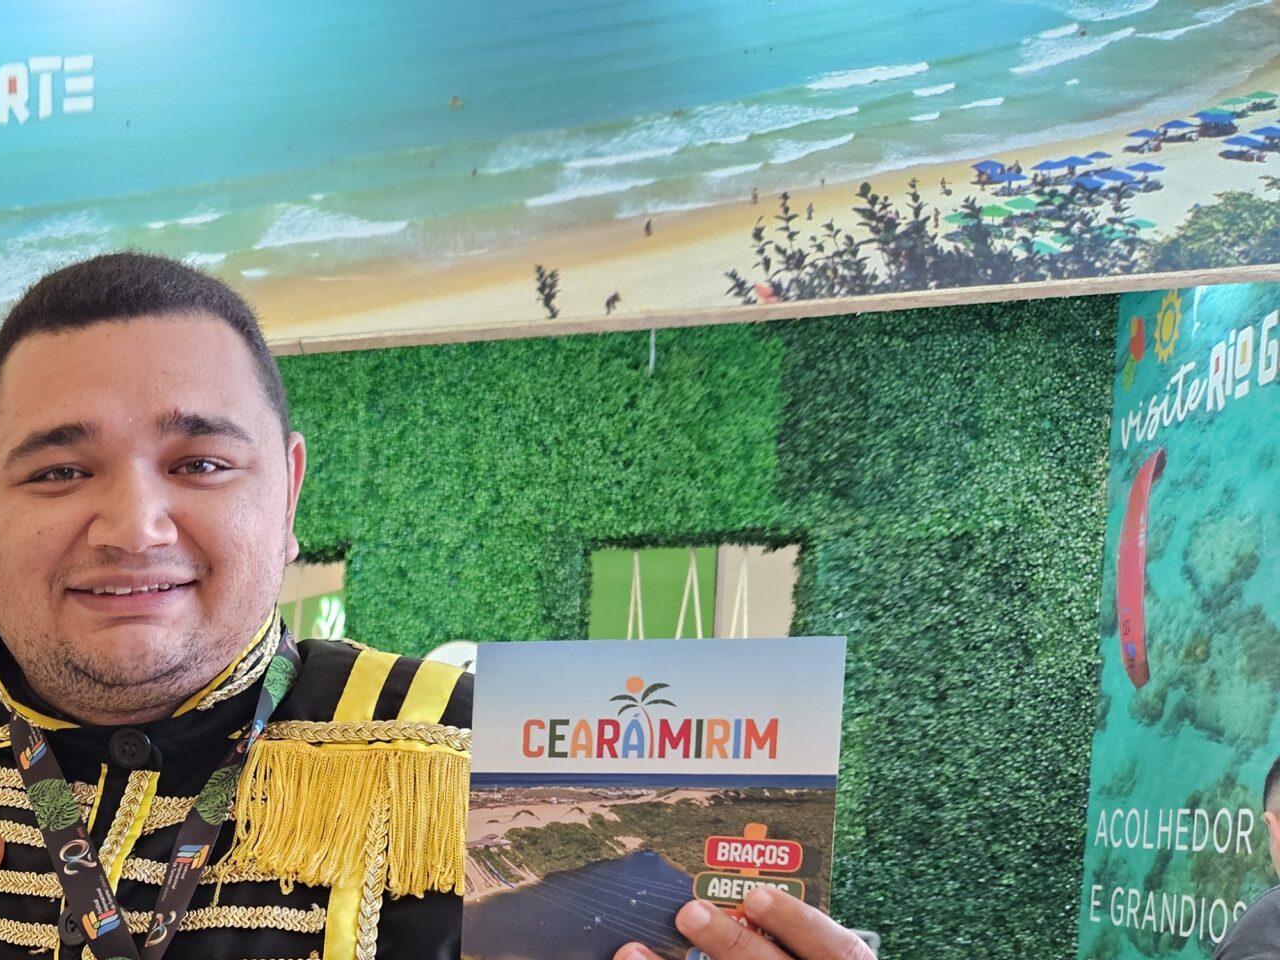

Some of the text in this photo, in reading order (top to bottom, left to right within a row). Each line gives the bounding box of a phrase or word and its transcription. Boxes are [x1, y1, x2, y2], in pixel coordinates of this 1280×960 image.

[1121, 361, 1208, 450] visite
[522, 712, 780, 759] CEARÁ MIRIM
[1094, 808, 1255, 855] ACOLHEDOR
[717, 842, 790, 867] BRAÇOS
[707, 877, 790, 900] ABER
[1090, 884, 1104, 923] E
